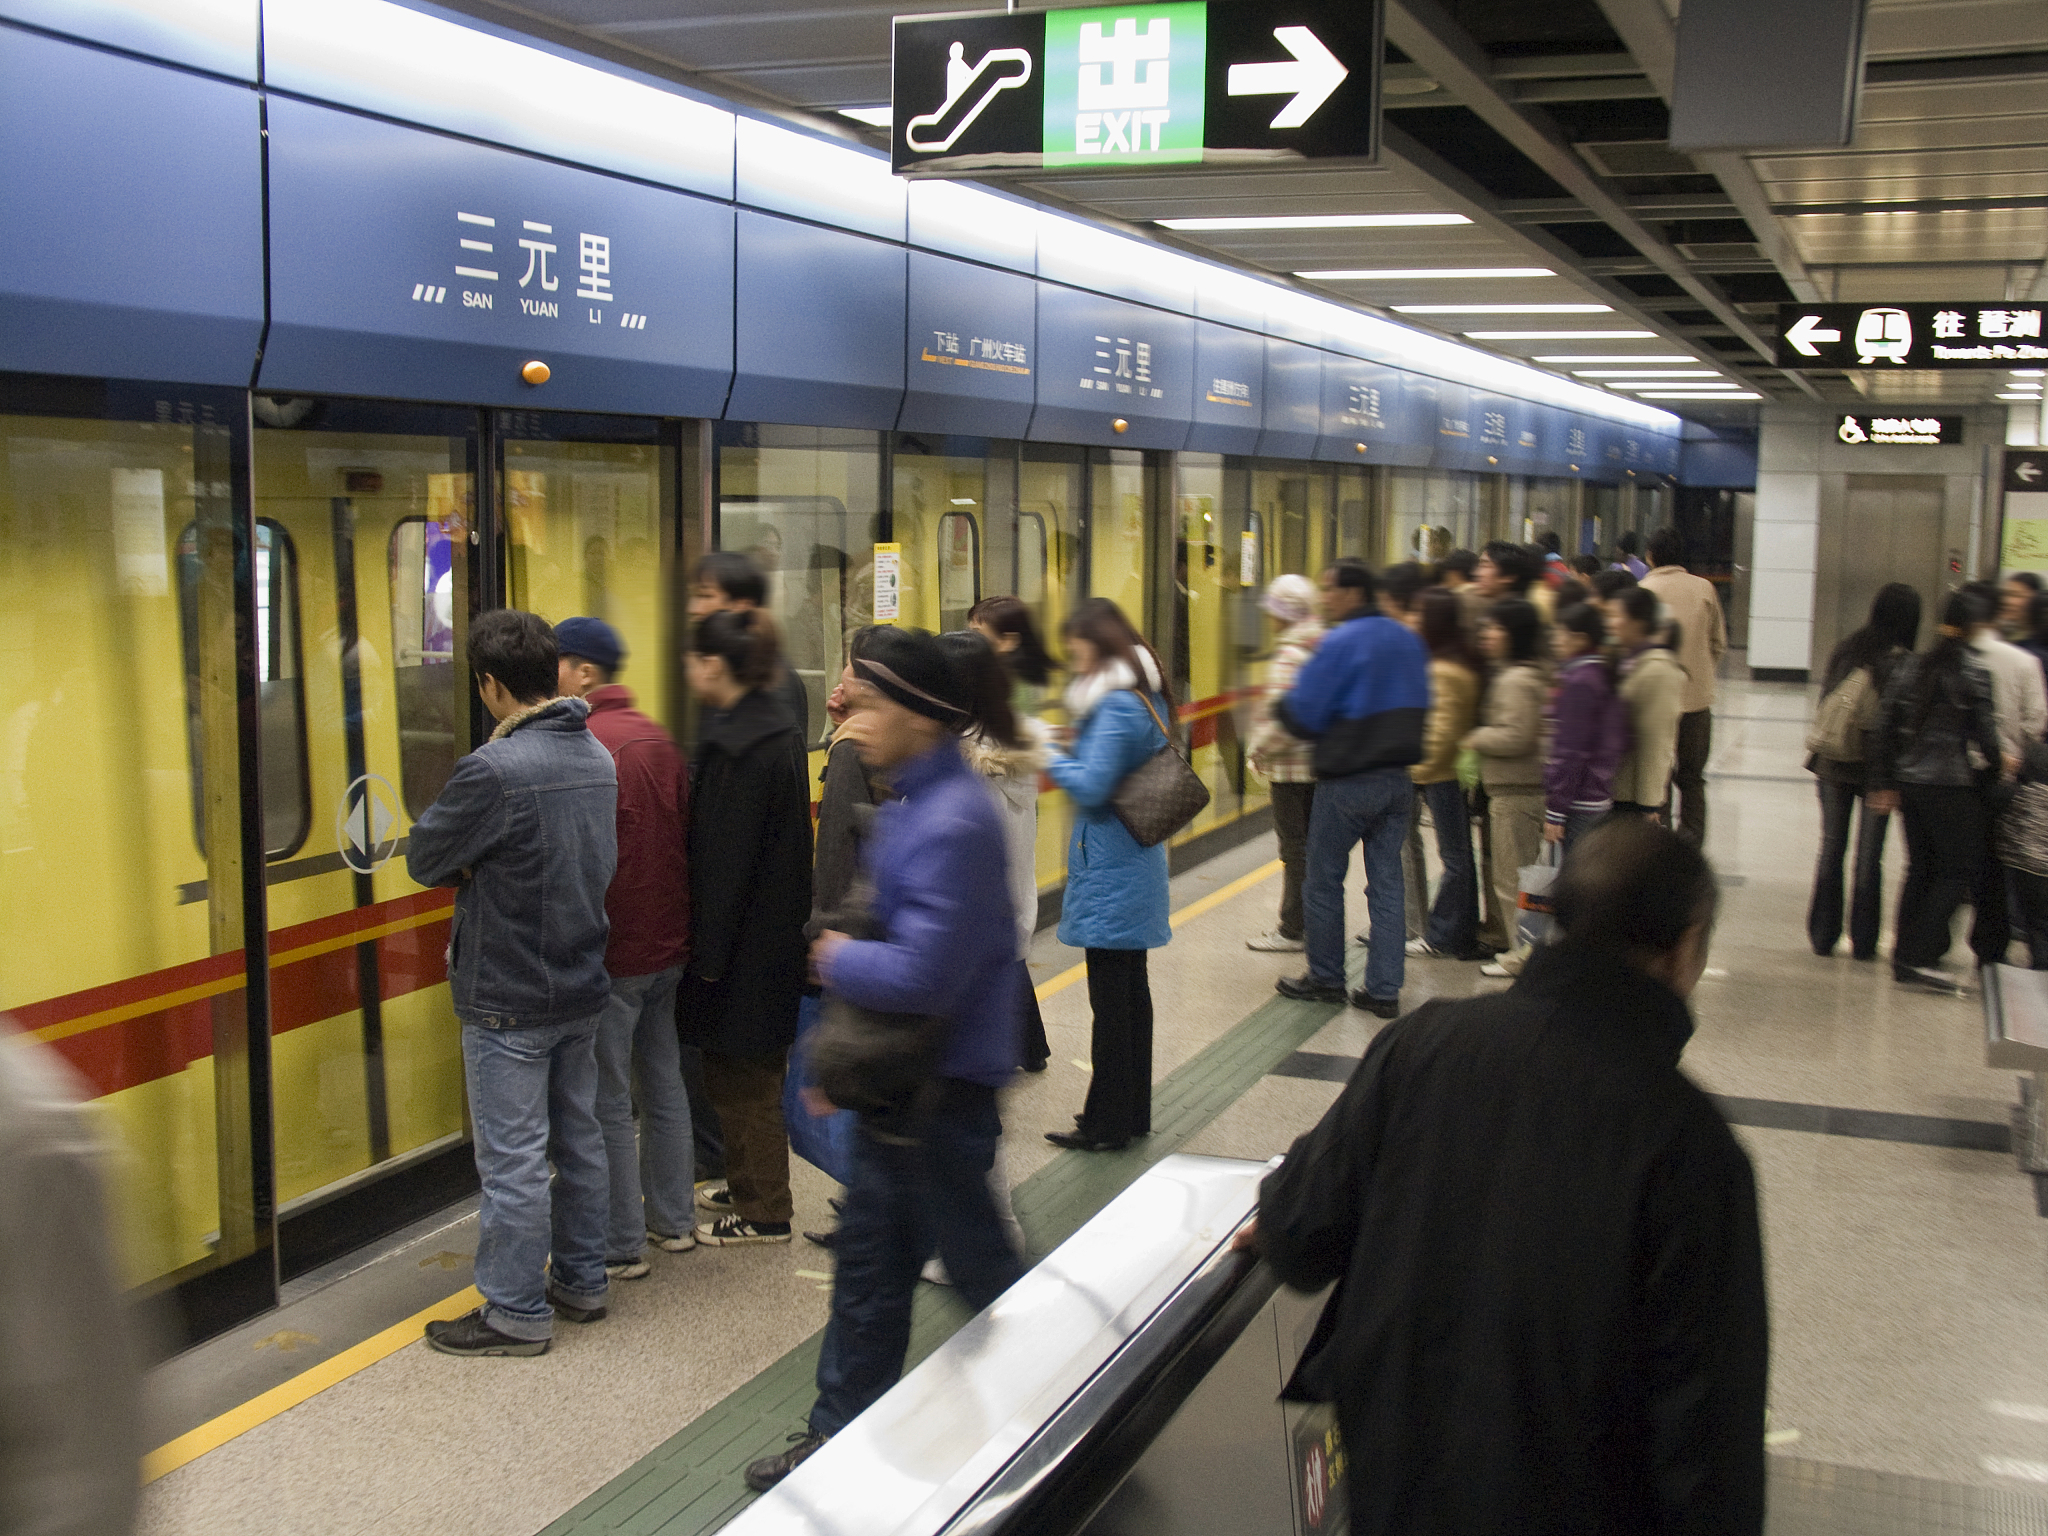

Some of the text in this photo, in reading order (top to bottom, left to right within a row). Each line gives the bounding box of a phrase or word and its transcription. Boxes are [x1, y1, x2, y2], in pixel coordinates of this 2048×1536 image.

[1075, 109, 1170, 154] EXIT
[455, 211, 613, 302] 三元里
[462, 290, 602, 324] SAN YUAN LI
[1093, 335, 1152, 383] 三元里
